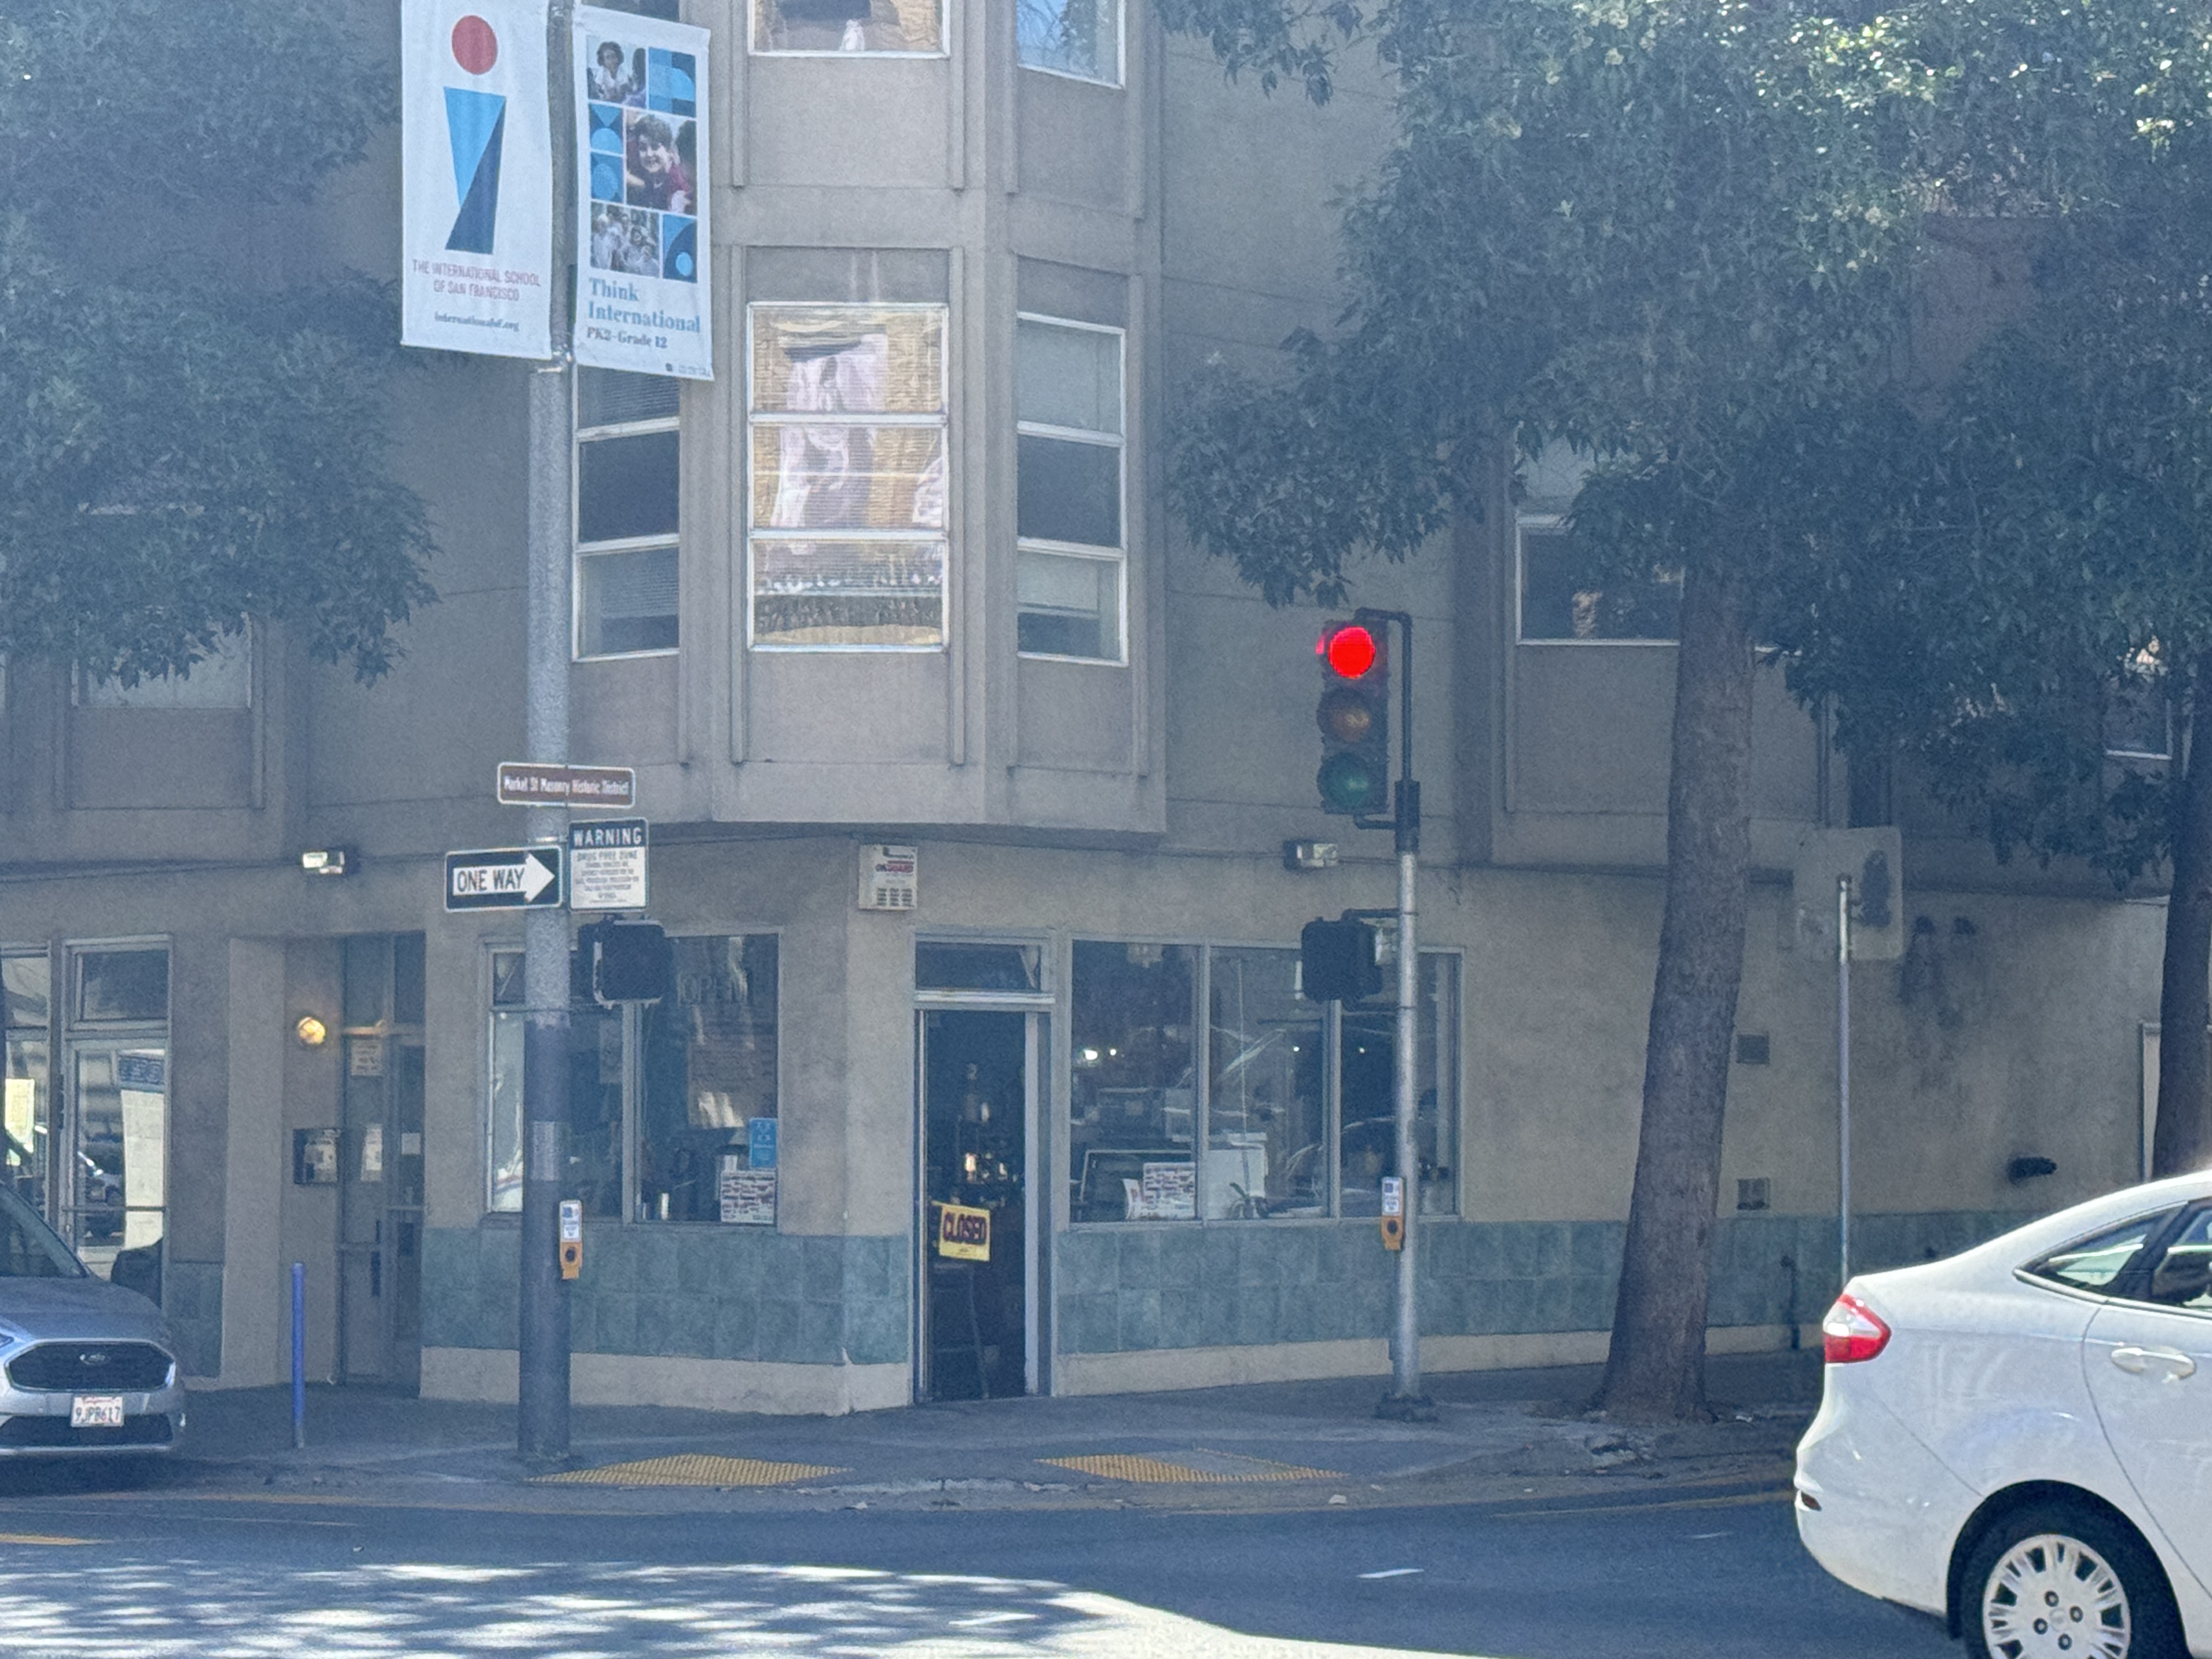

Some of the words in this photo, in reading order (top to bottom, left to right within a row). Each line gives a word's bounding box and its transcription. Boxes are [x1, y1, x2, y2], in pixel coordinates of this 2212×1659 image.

[413, 259, 430, 274] THE
[432, 262, 501, 283] INTERNATIONAL
[504, 270, 541, 287] SCHOOL
[433, 279, 445, 292] OF
[448, 281, 466, 295] SAN
[469, 283, 520, 301] FRANCISCO
[588, 277, 639, 301] Think
[588, 301, 701, 333] International
[655, 336, 668, 348] 12
[573, 827, 642, 847] WARNING
[457, 870, 487, 892] ONE
[493, 867, 525, 890] WAY
[943, 1212, 987, 1246] CLOSED
